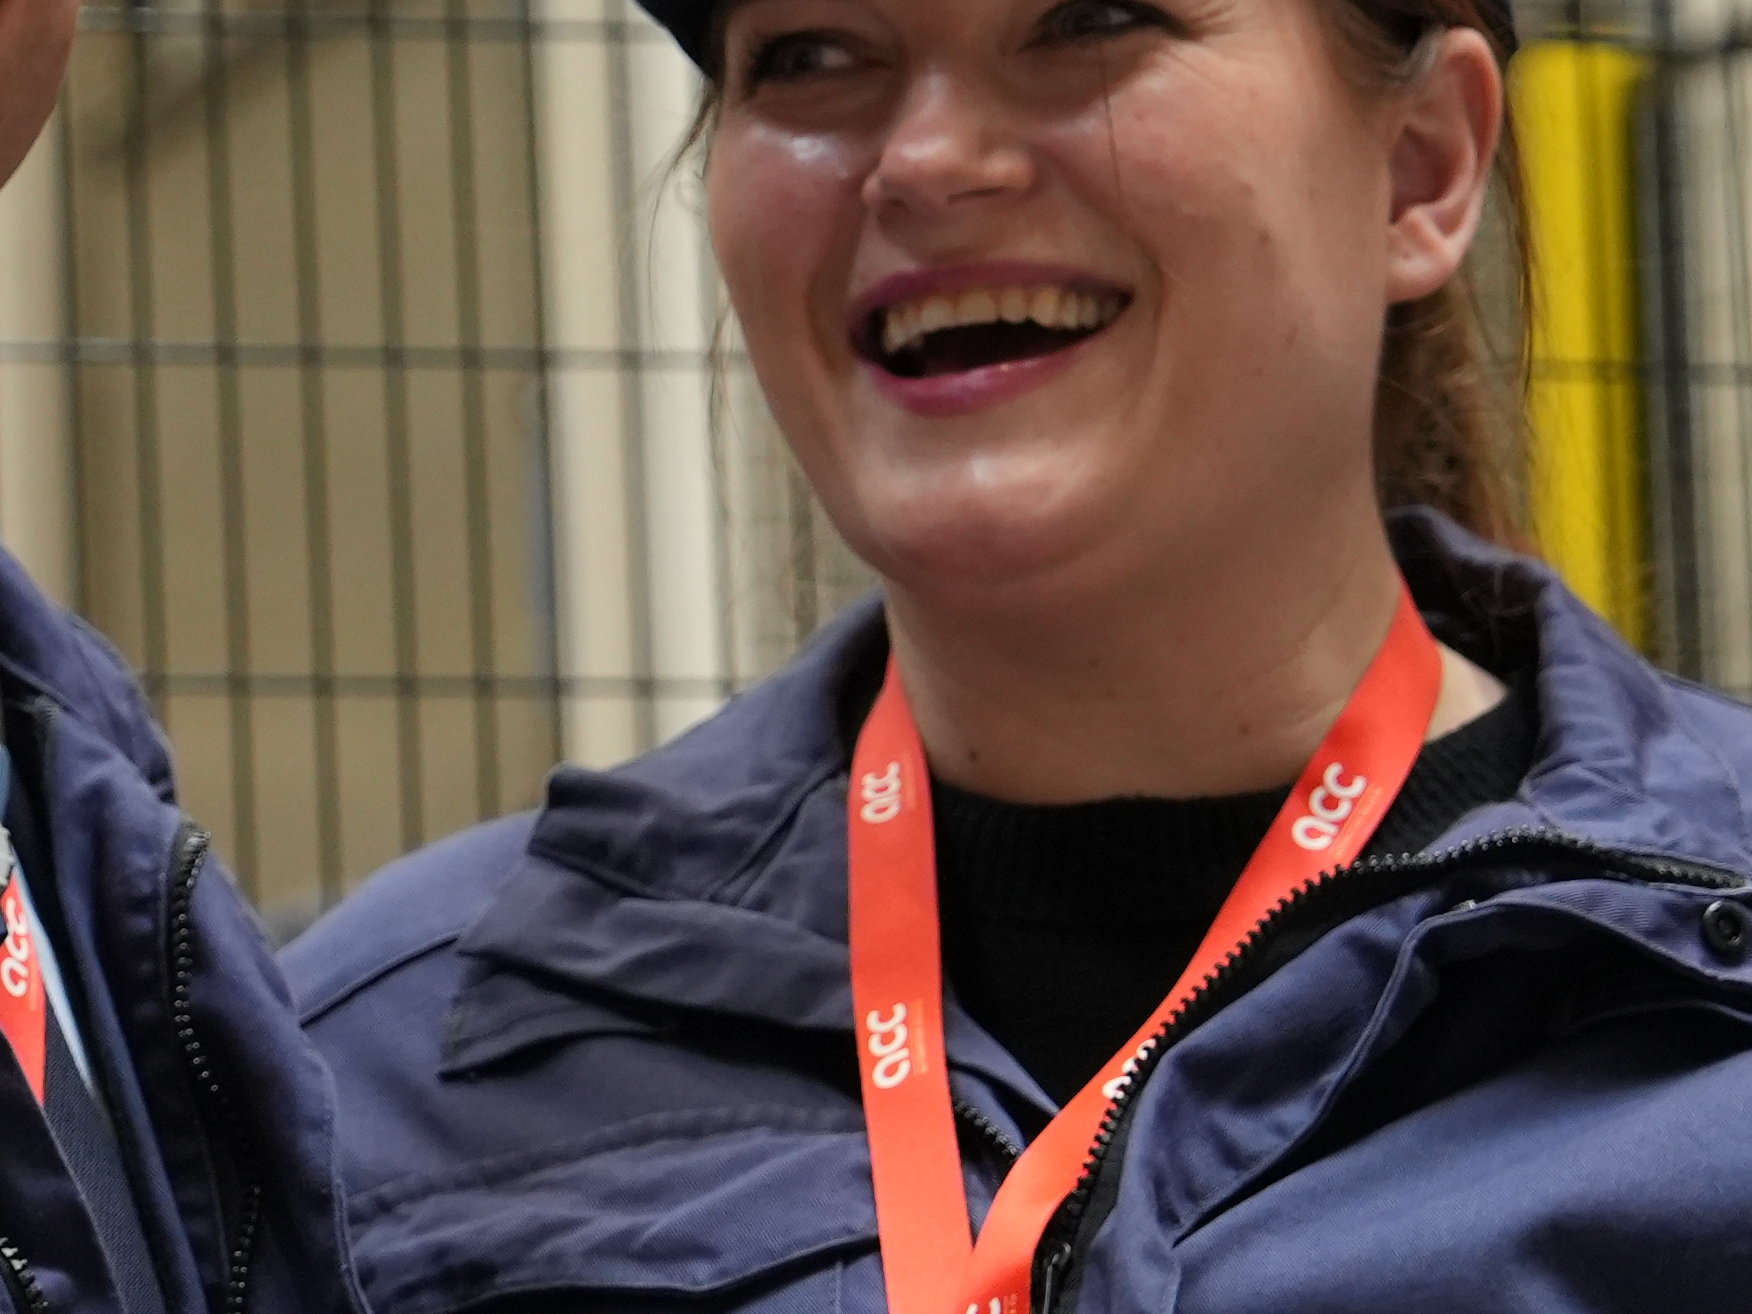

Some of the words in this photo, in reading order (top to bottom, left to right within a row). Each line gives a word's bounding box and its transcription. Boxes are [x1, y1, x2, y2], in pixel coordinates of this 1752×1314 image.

[859, 760, 902, 824] acc
[1290, 761, 1367, 851] acc
[0, 896, 30, 998] acc
[865, 1001, 911, 1089] acc
